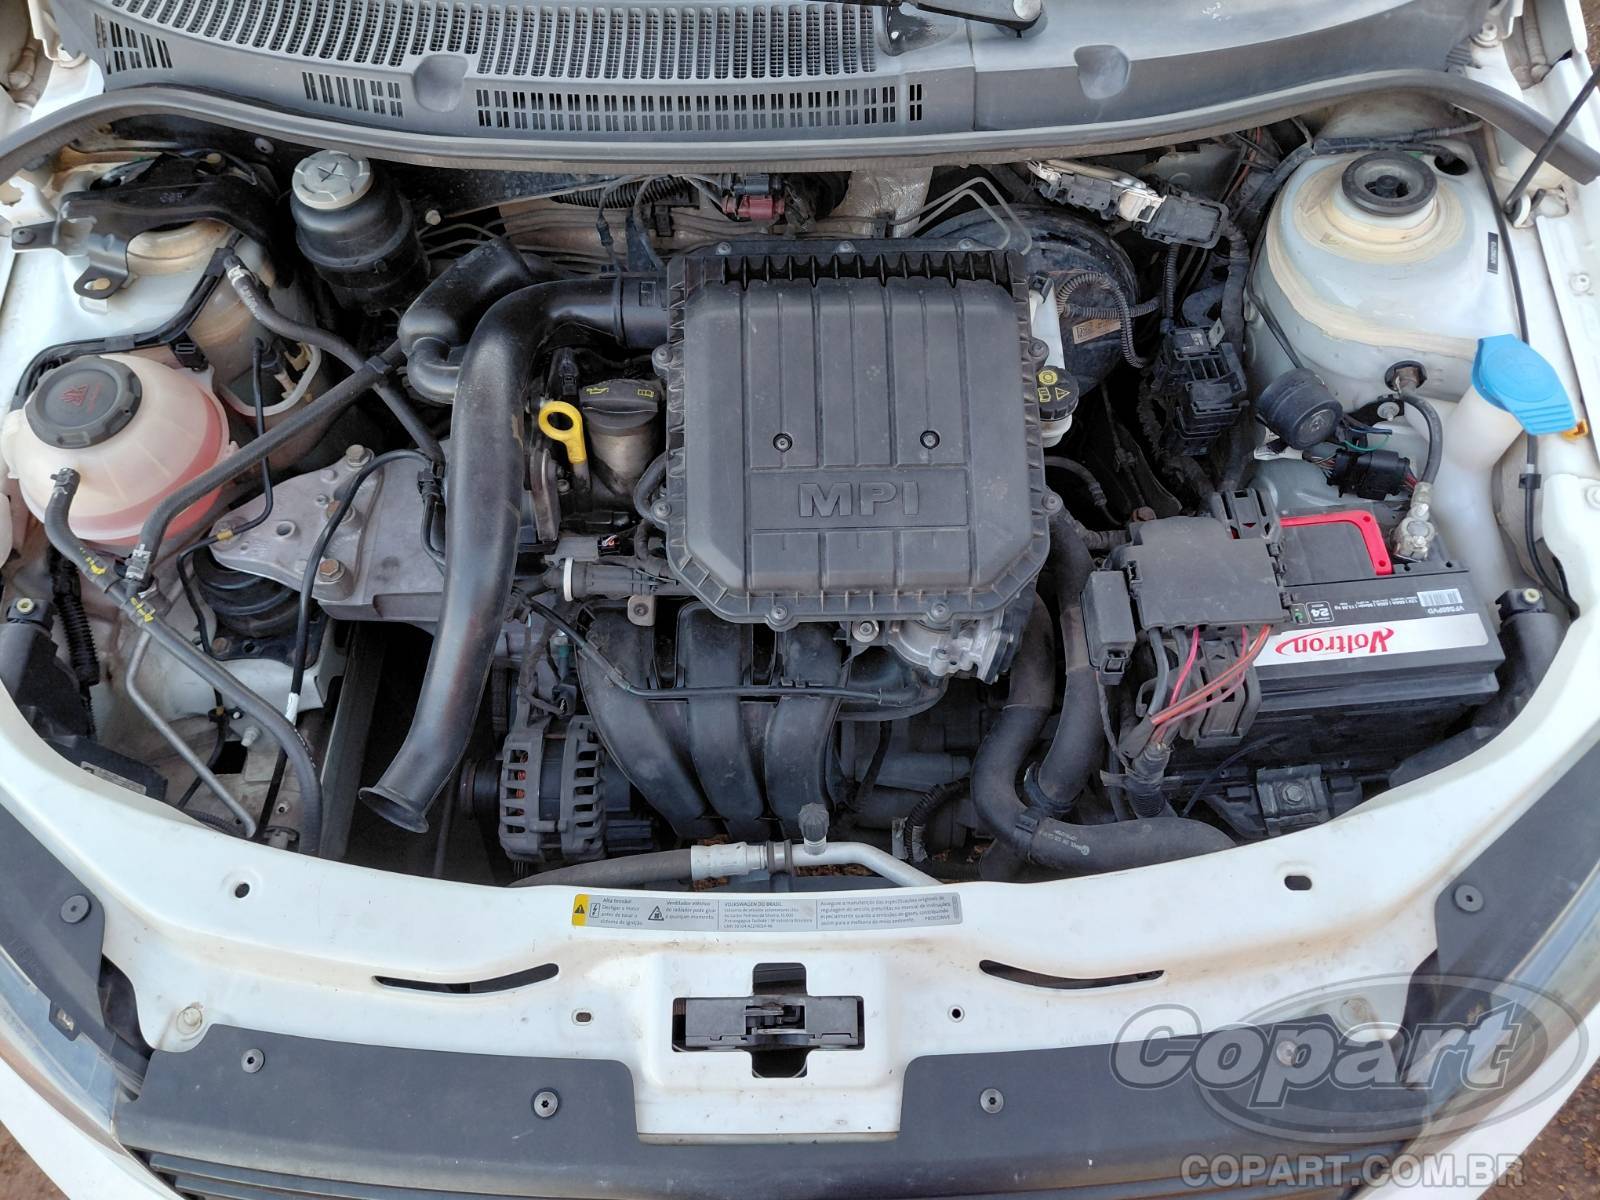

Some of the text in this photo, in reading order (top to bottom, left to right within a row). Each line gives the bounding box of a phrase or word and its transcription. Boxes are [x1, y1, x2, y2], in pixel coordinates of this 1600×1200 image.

[798, 481, 919, 517] MPI
[1310, 609, 1329, 617] 24
[1291, 628, 1394, 655] Voltron
